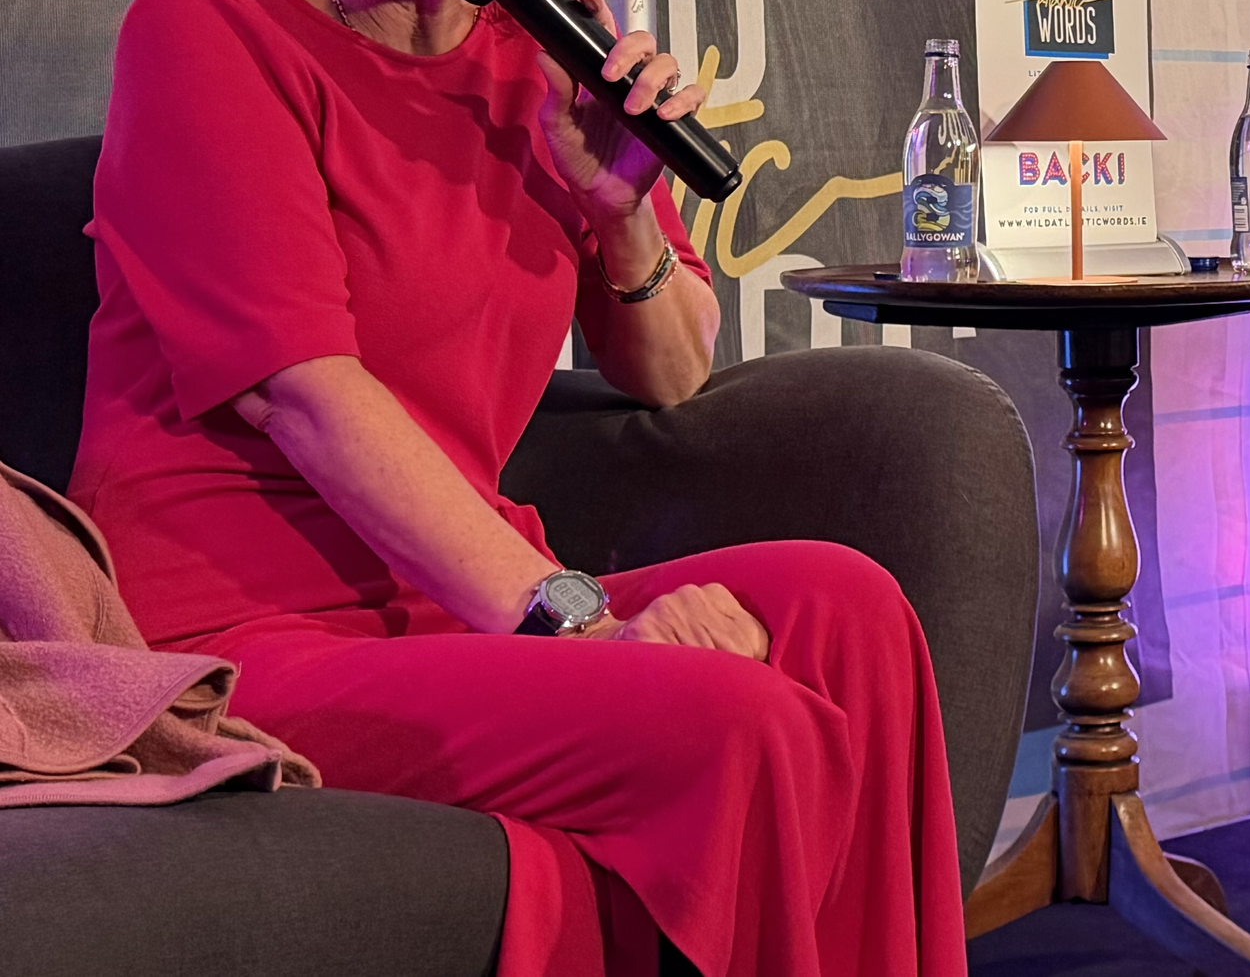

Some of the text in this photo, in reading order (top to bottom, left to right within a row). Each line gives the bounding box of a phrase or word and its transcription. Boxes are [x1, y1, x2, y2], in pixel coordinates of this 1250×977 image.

[1036, 3, 1097, 44] WORDS
[1024, 206, 1039, 214] FOR
[998, 217, 1147, 228] WWW.WILDATLTICWORDS.IE
[906, 232, 965, 242] BALLYGOWAN
